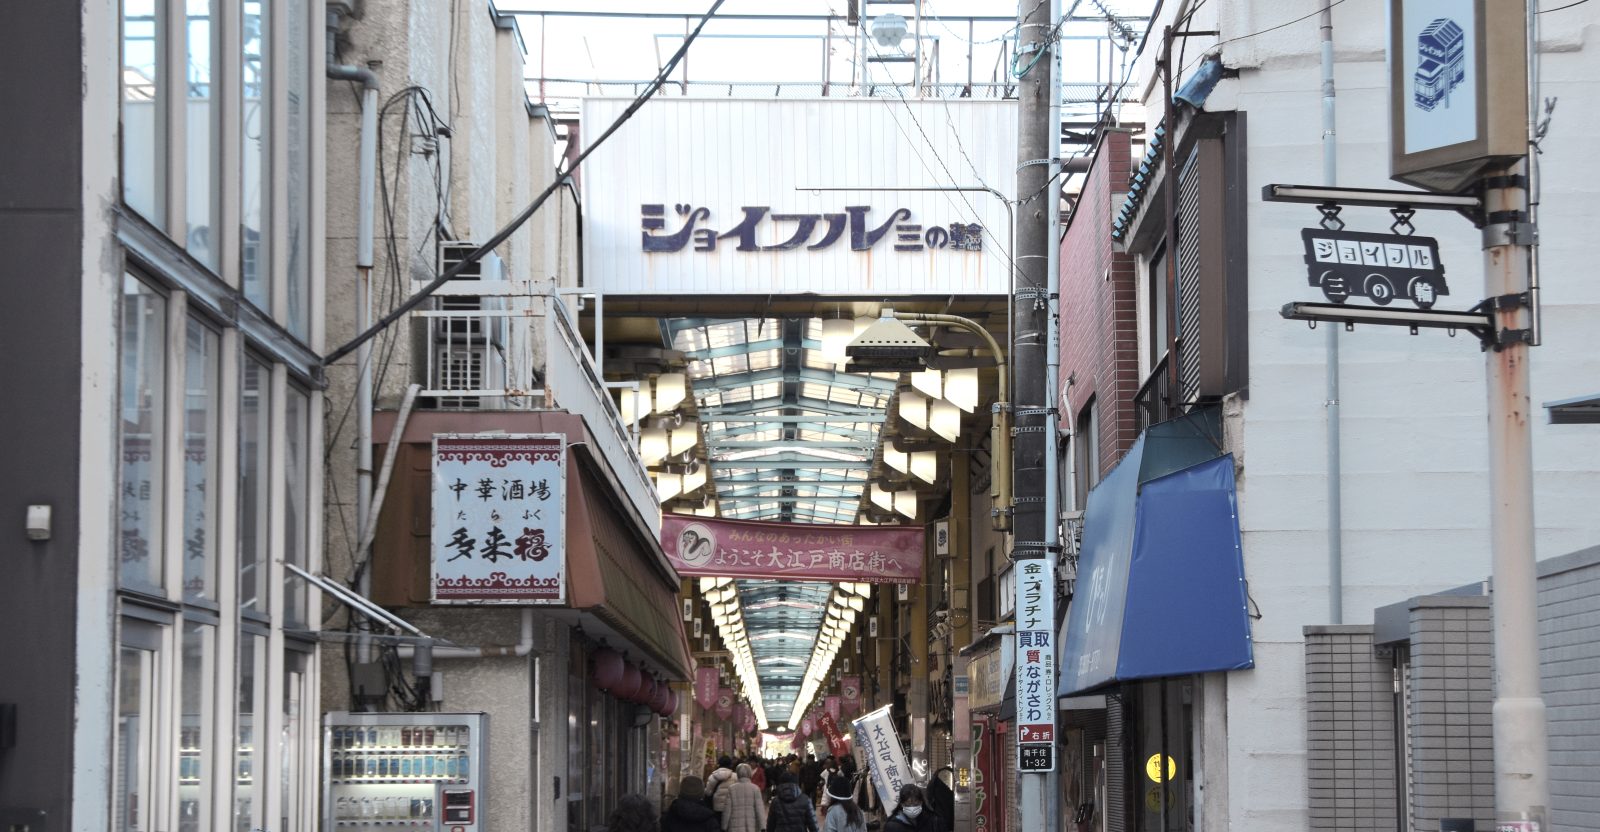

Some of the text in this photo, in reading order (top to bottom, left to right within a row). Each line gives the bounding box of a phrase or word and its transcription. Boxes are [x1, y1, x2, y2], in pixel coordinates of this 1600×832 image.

[1317, 241, 1430, 267] ジョイフル
[1327, 277, 1434, 303] 三の輪
[448, 477, 551, 502] 中華酒場
[457, 509, 542, 521] たらふく
[444, 526, 553, 563] 多来福
[728, 529, 853, 546] みんなのあったかい街
[715, 546, 903, 573] ようこそ大江戸商店街へ
[1019, 631, 1050, 648] 買取
[1026, 649, 1042, 722] 質ながさわ
[1032, 731, 1051, 740] 右折
[1023, 748, 1047, 757] 南千住
[1025, 758, 1046, 767] 1-32
